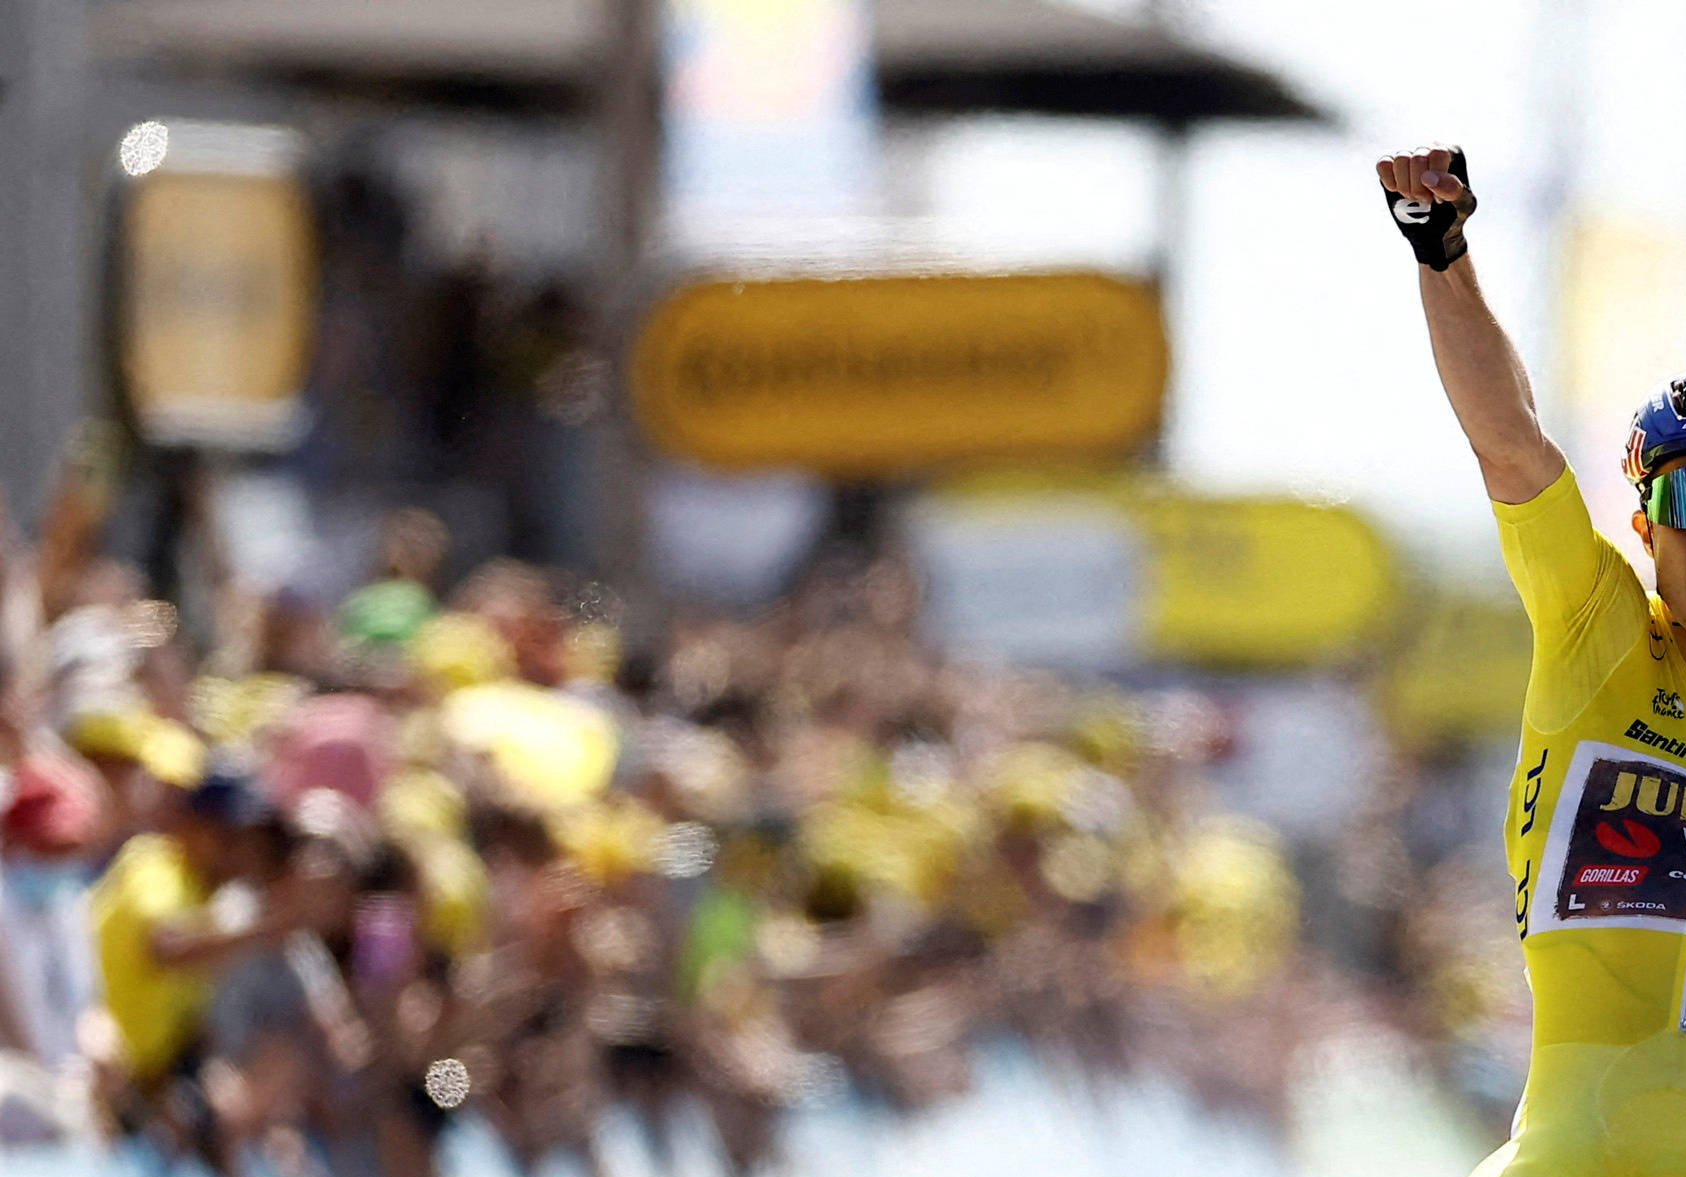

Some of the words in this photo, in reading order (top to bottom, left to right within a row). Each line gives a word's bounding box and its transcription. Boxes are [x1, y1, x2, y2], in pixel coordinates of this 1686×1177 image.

[1521, 748, 1548, 837] LCL
[1516, 860, 1530, 940] LCL
[1580, 868, 1640, 883] GORILLAS
